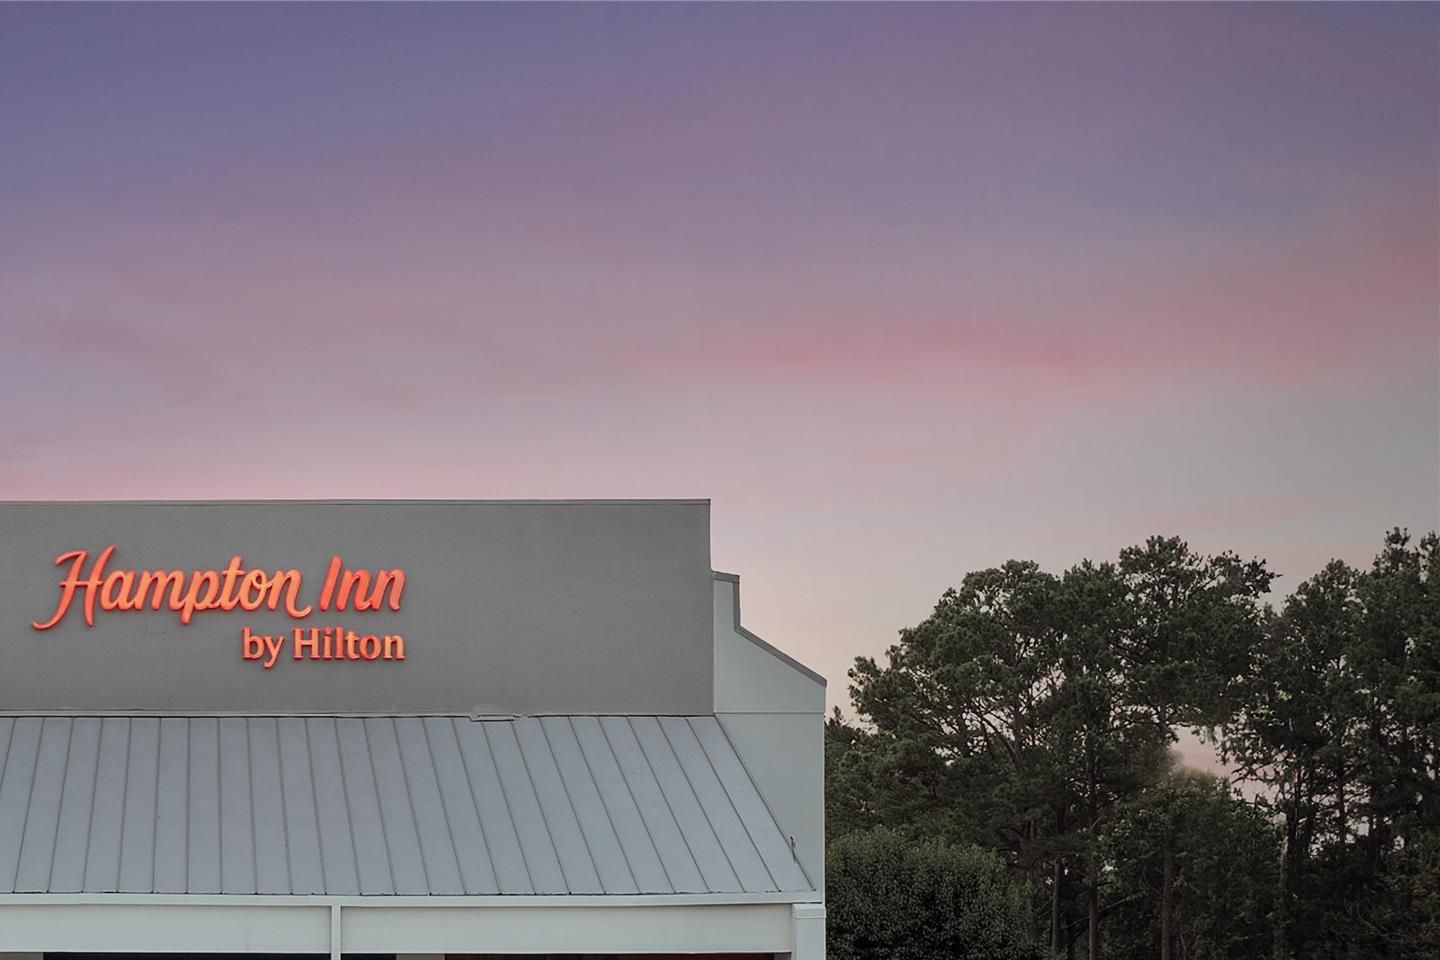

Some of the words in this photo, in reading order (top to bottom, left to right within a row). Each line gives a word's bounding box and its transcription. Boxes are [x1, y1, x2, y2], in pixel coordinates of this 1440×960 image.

[31, 543, 313, 630] Hampton
[319, 555, 407, 611] Inn
[240, 626, 285, 668] by
[291, 626, 406, 660] Hilton
